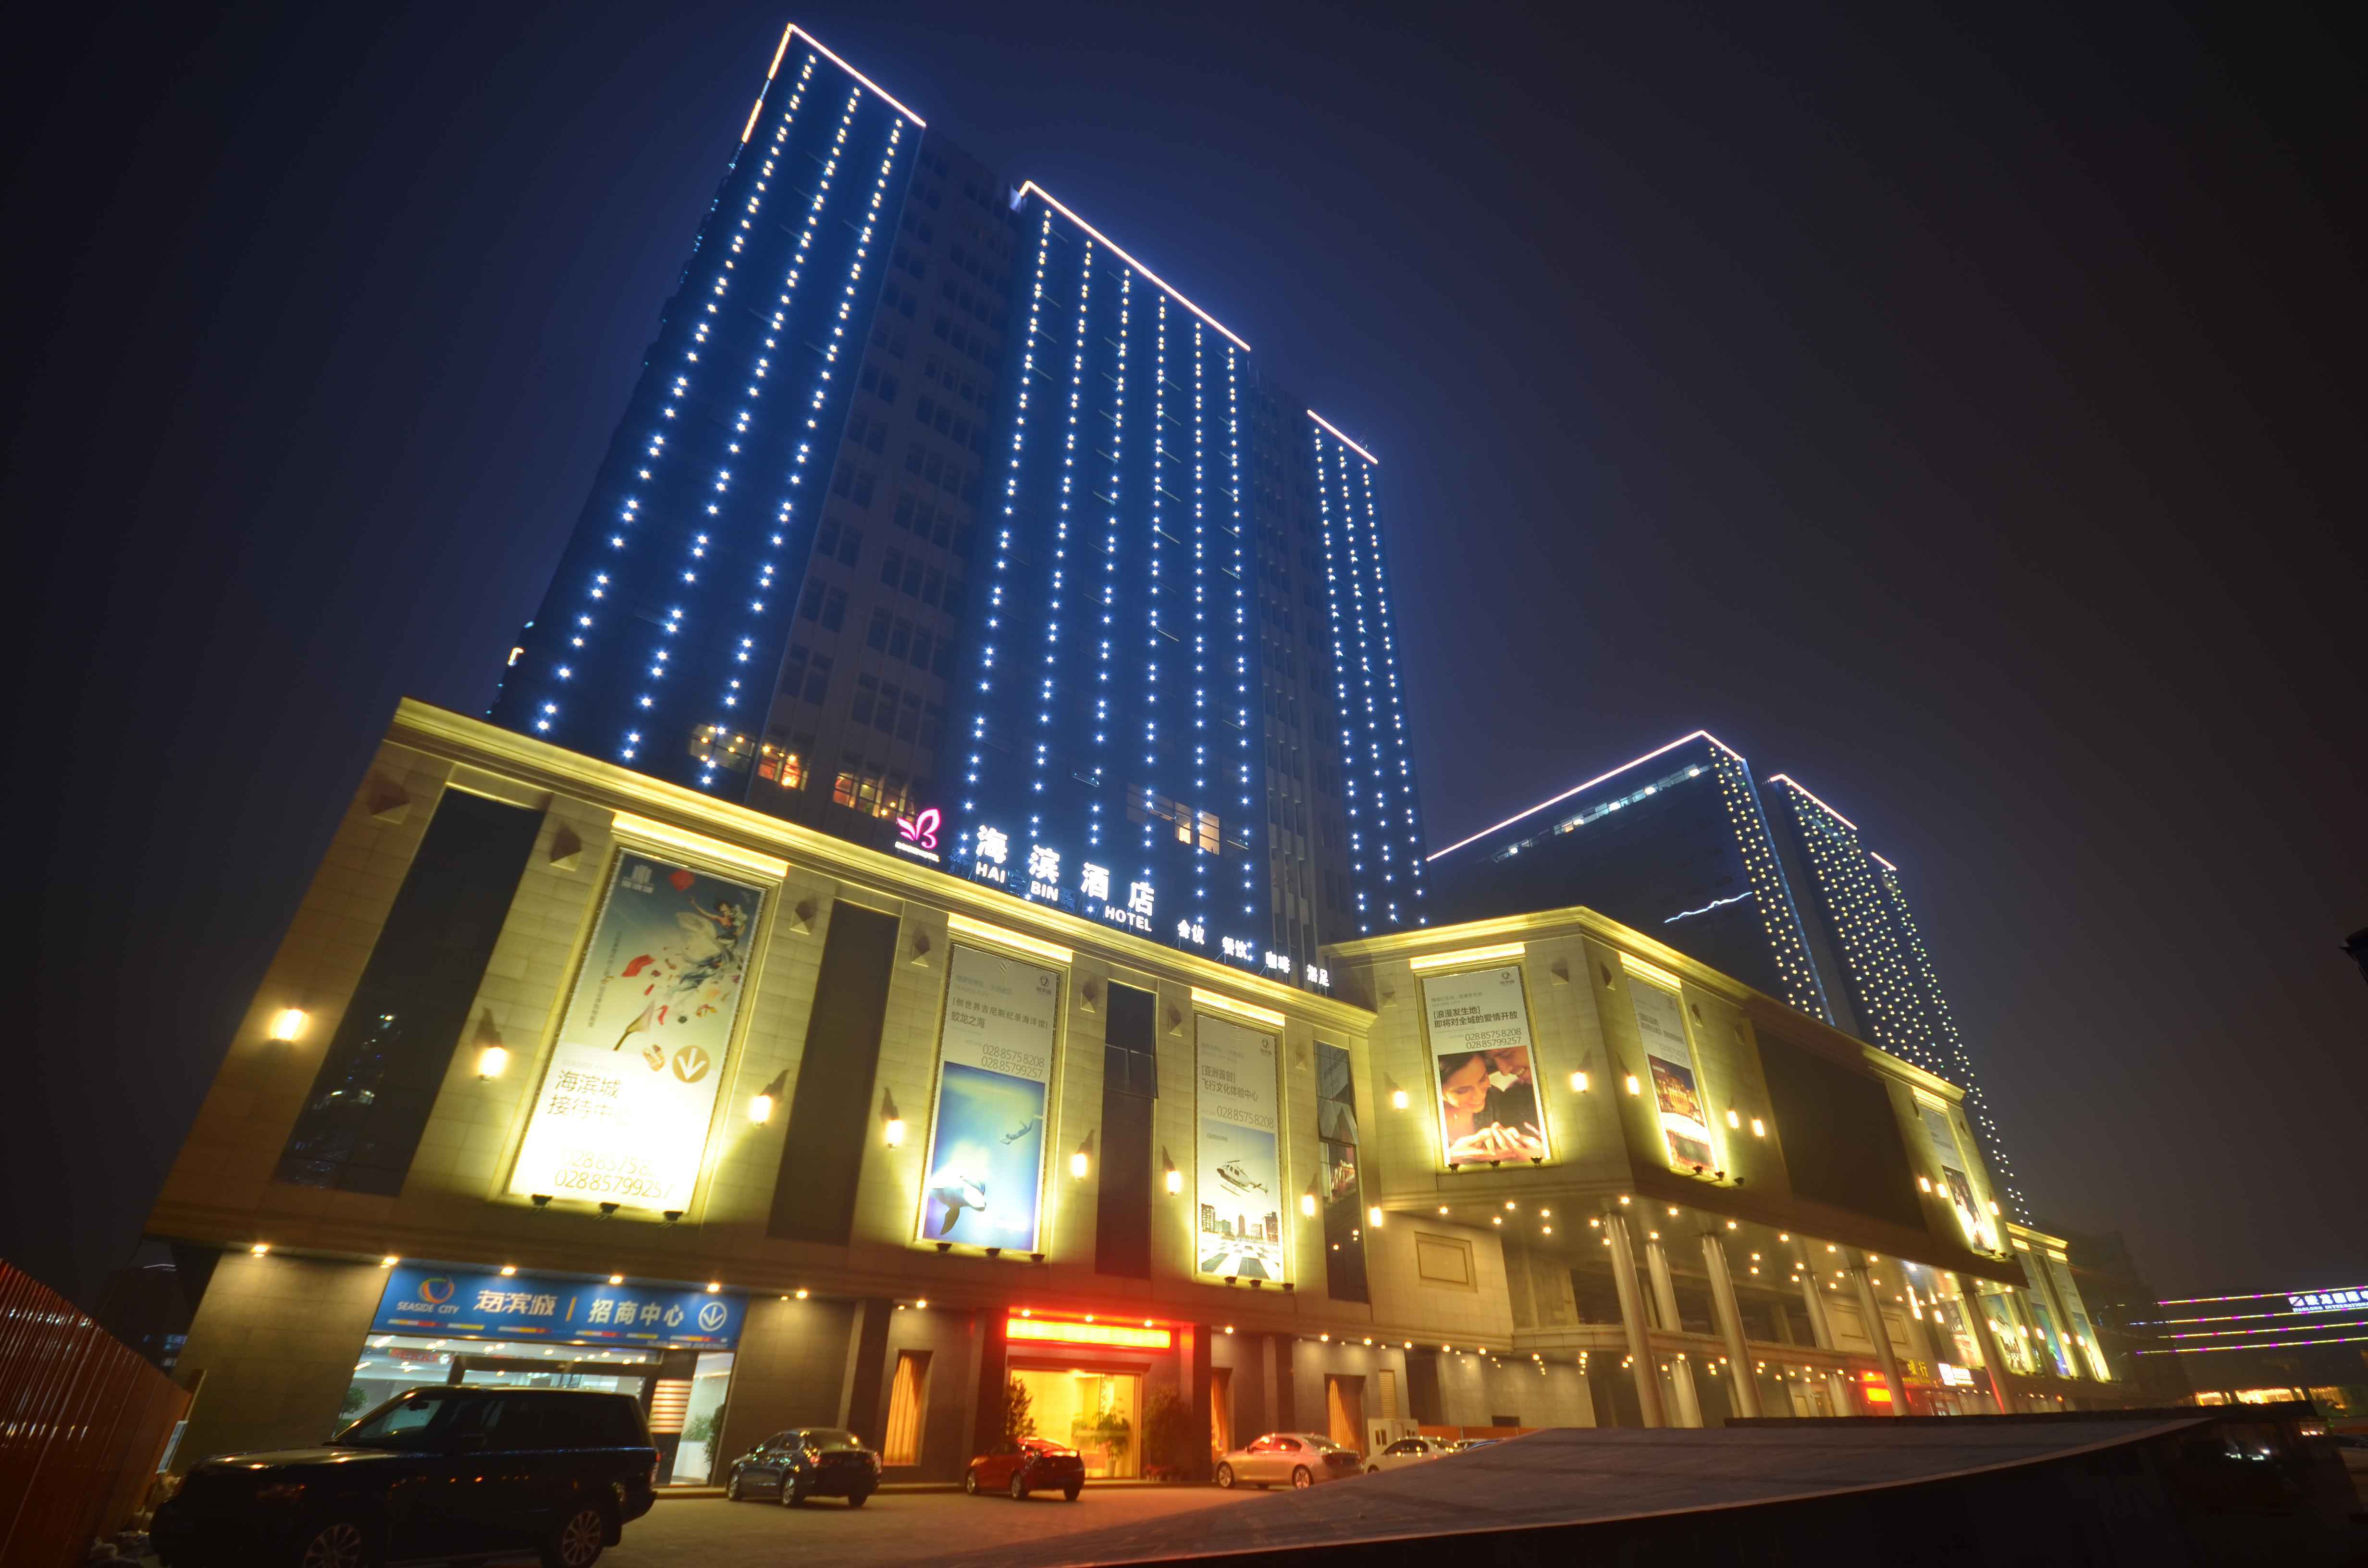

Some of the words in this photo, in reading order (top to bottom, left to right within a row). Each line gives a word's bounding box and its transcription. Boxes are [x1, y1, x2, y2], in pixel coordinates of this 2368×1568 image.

[976, 825, 1154, 916] 海滨酒店
[975, 861, 1005, 883] HAI
[1031, 881, 1059, 901] BIN
[1105, 906, 1152, 932] HOTEL
[1178, 919, 1205, 945] 会议
[1434, 1011, 1518, 1028] 即将对全城的爱情开放
[555, 1070, 621, 1098] 海滨城
[397, 1301, 434, 1312] SEASIDE
[438, 1304, 460, 1314] CITY
[473, 1289, 557, 1316] 海滨城
[587, 1298, 684, 1327] 招商中心
